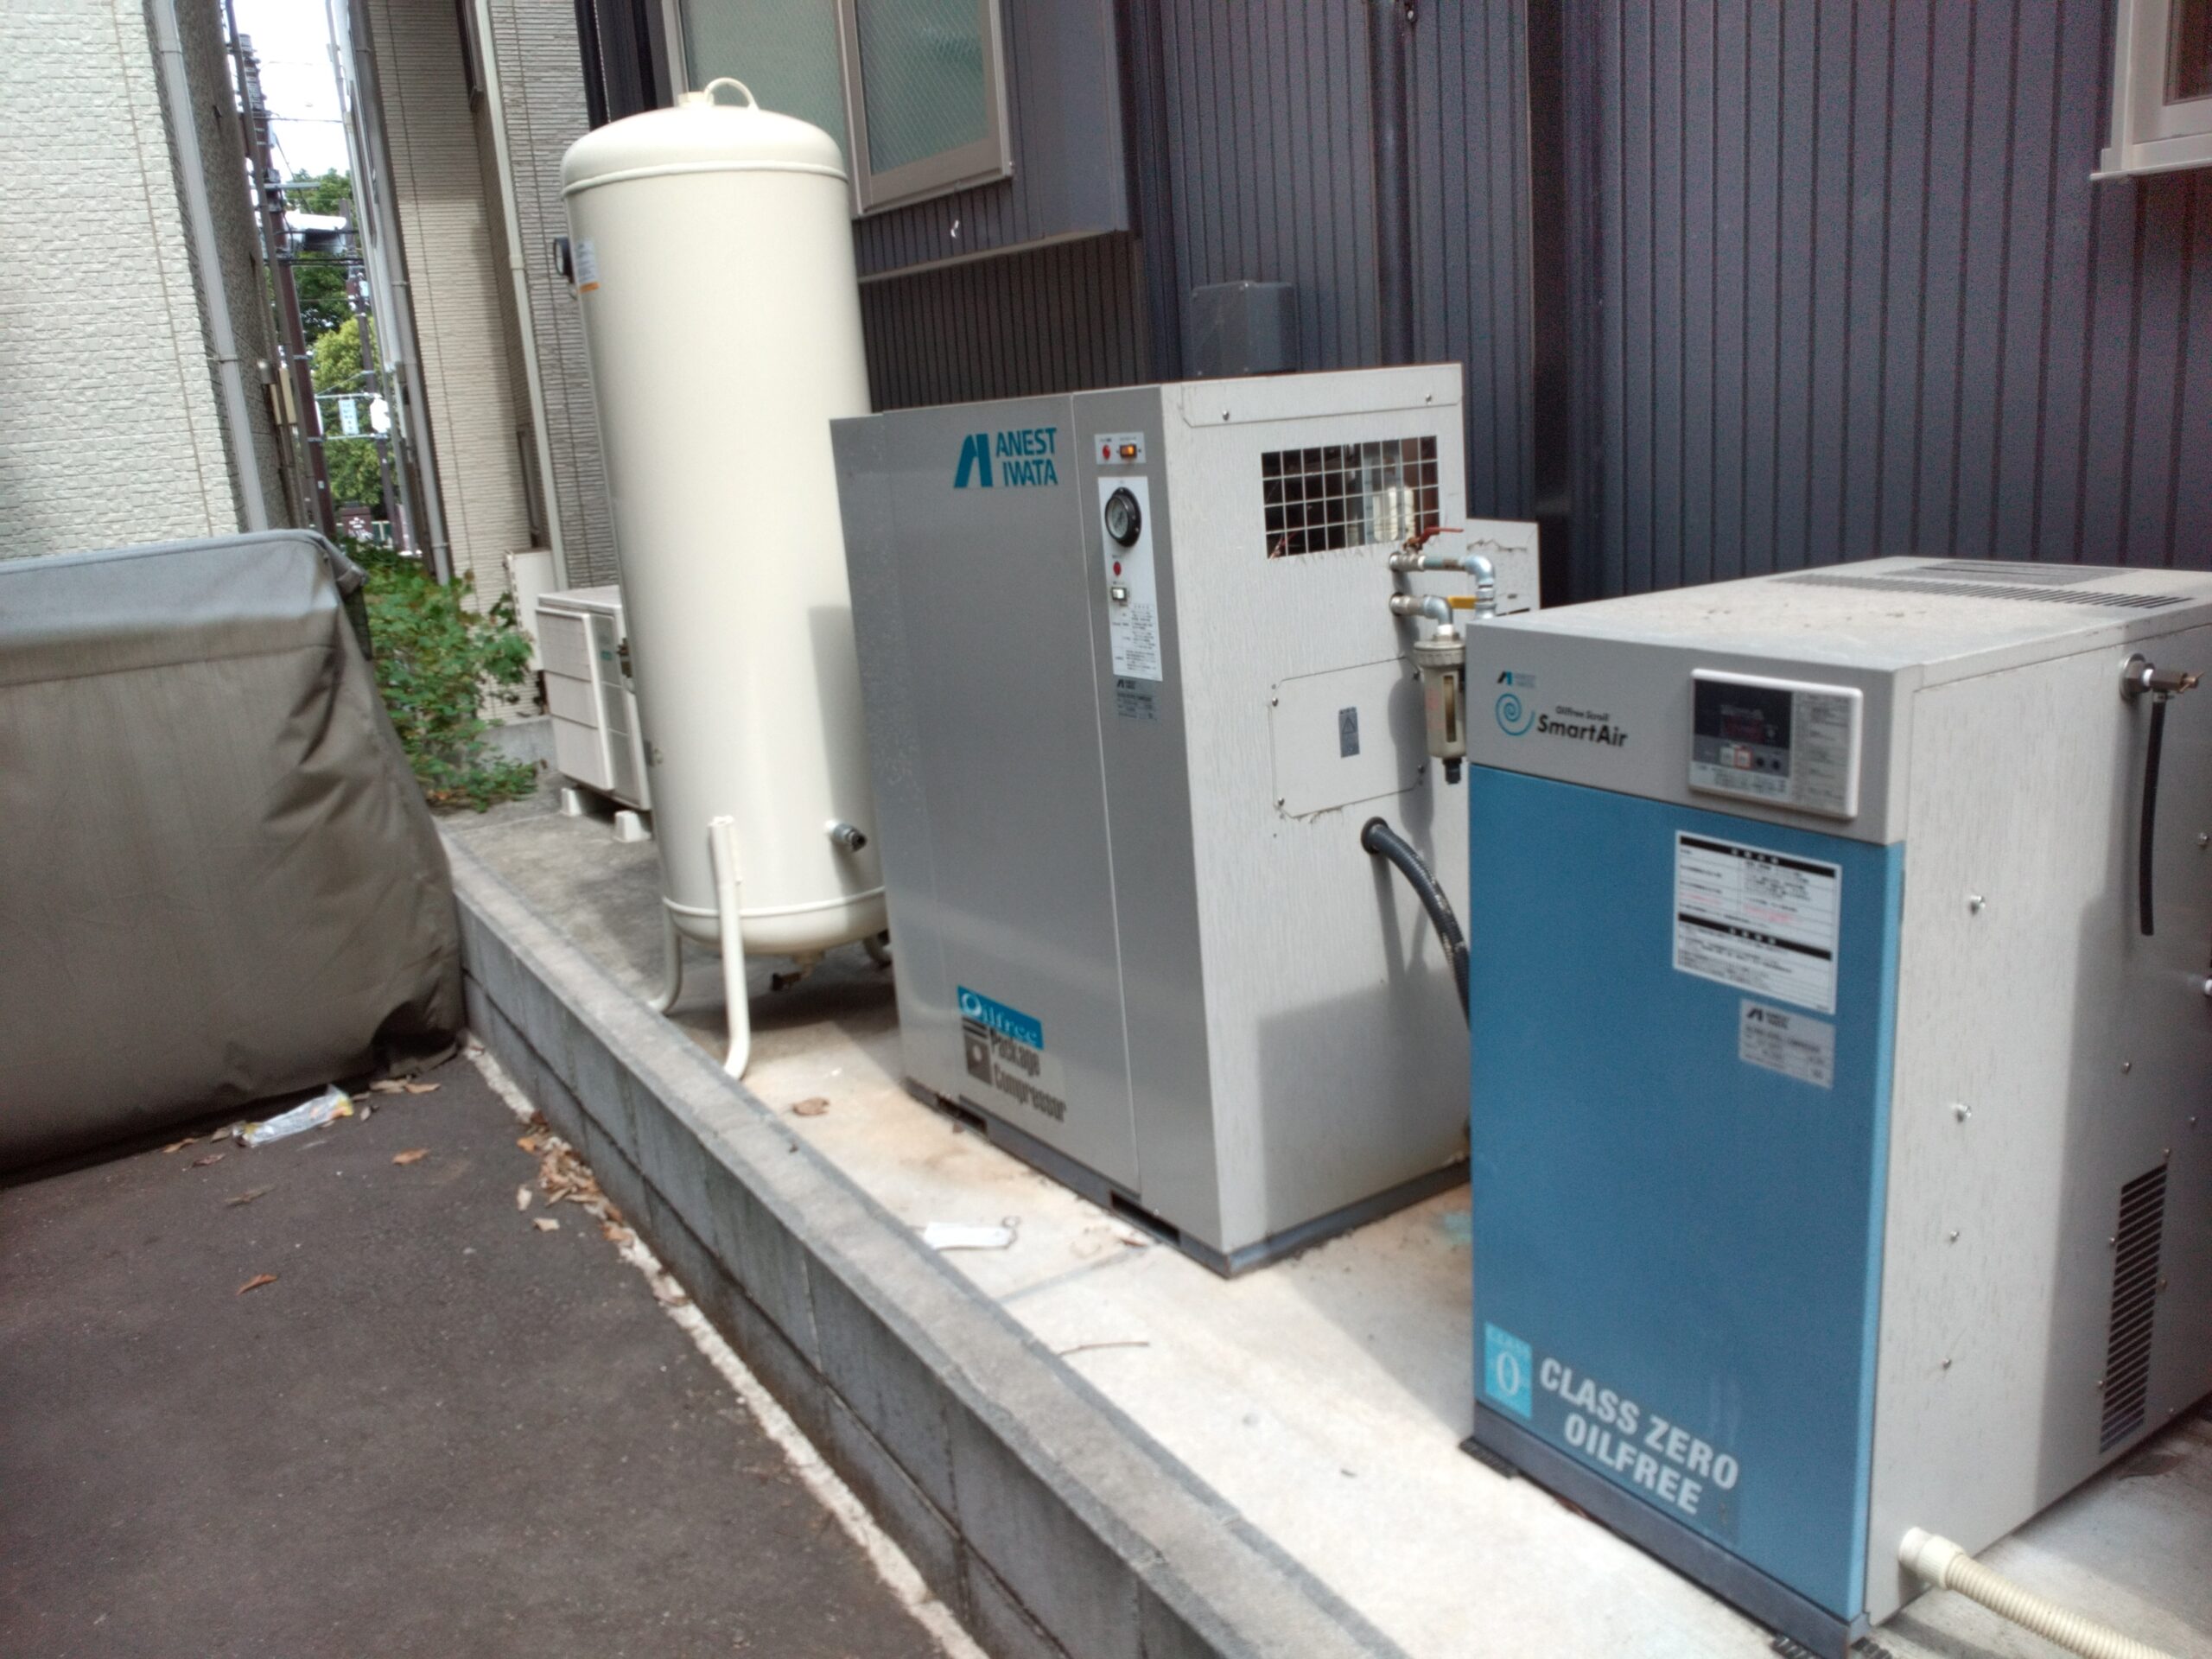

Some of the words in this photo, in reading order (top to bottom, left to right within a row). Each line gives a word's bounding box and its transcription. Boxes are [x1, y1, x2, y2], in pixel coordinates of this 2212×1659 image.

[995, 427, 1057, 457] ANEST
[1003, 459, 1058, 486] IWATA
[1537, 714, 1628, 747] SmartAir
[962, 993, 1038, 1044] Oilfree
[1540, 1357, 1640, 1435] CLASS
[1645, 1414, 1738, 1491] ZERO
[1564, 1413, 1703, 1515] OILFREE
